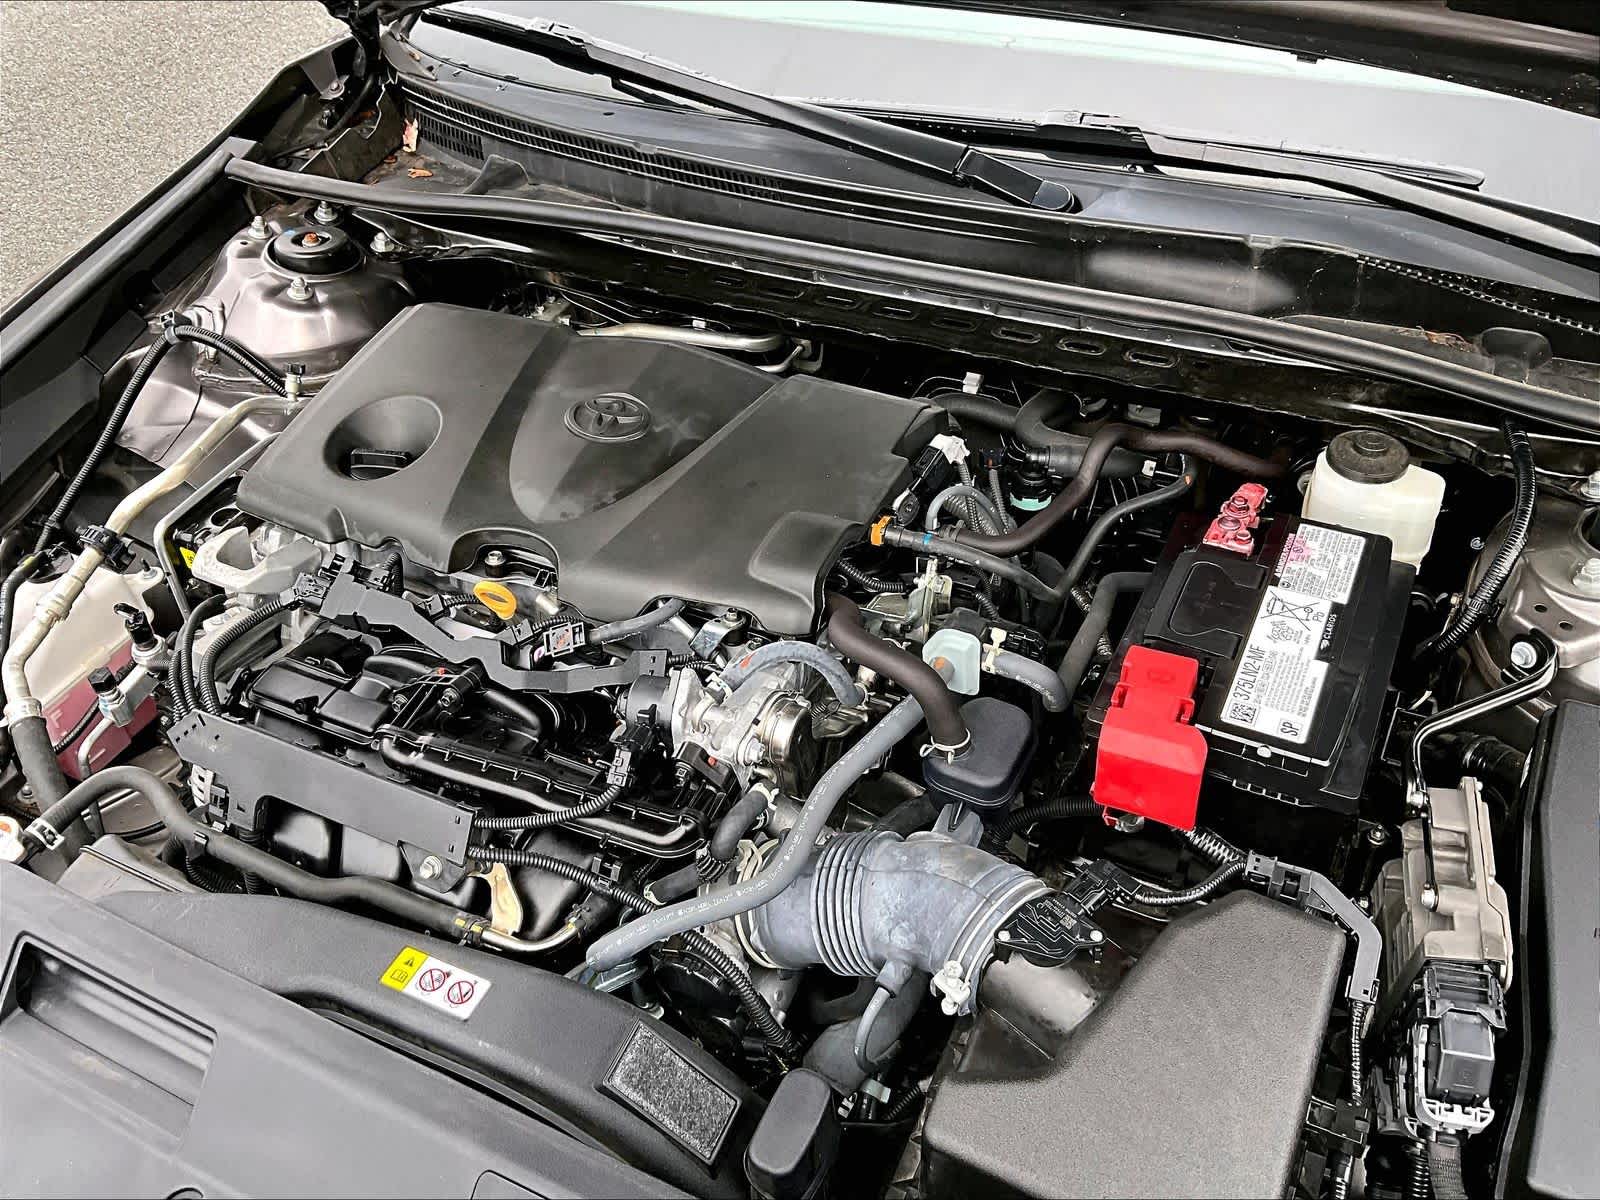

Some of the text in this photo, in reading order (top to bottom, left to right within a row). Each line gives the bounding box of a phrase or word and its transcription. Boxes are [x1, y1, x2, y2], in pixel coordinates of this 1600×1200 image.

[1313, 612, 1325, 622] Pb
[1324, 614, 1337, 640] CLARIOS
[1232, 643, 1265, 701] 375LN2-MF
[1280, 721, 1300, 737] SP
